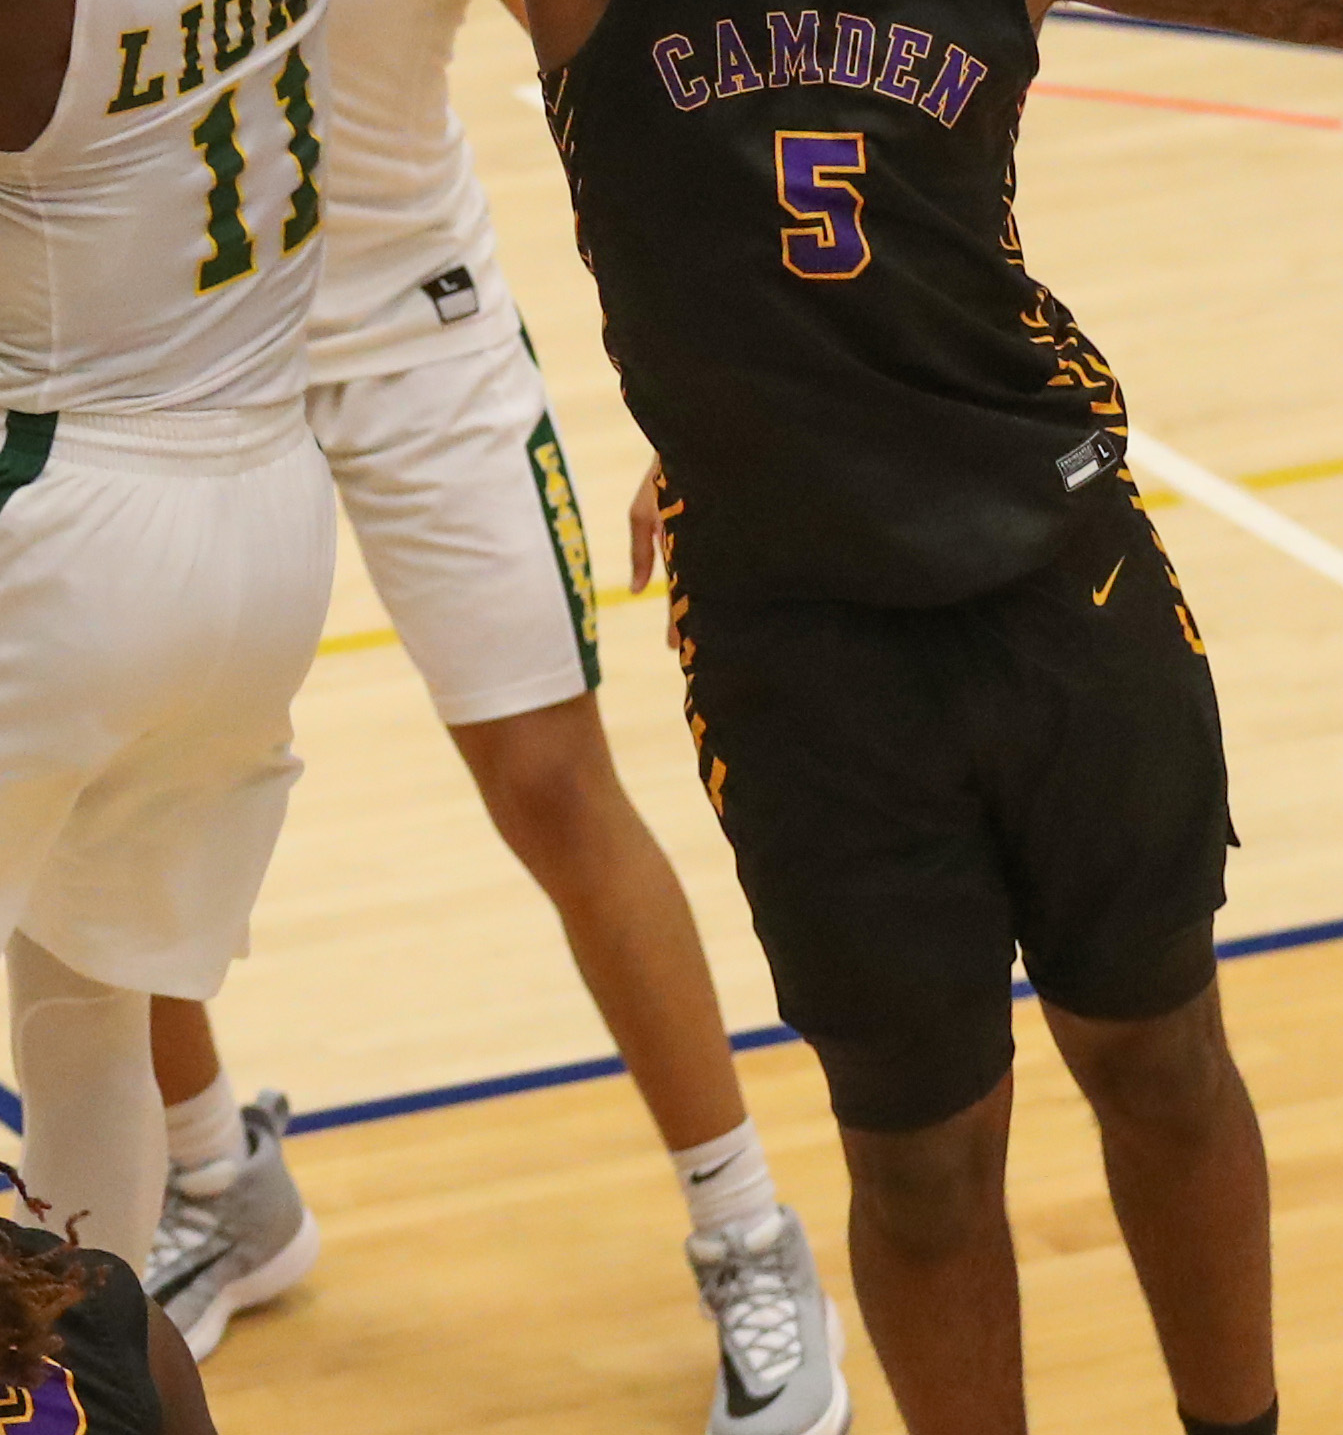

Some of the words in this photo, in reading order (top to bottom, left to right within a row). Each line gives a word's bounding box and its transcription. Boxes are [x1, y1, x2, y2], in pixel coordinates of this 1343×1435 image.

[652, 9, 988, 129] CAMDEN
[192, 44, 322, 297] 11
[775, 130, 872, 280] 5
[1097, 443, 1110, 459] L
